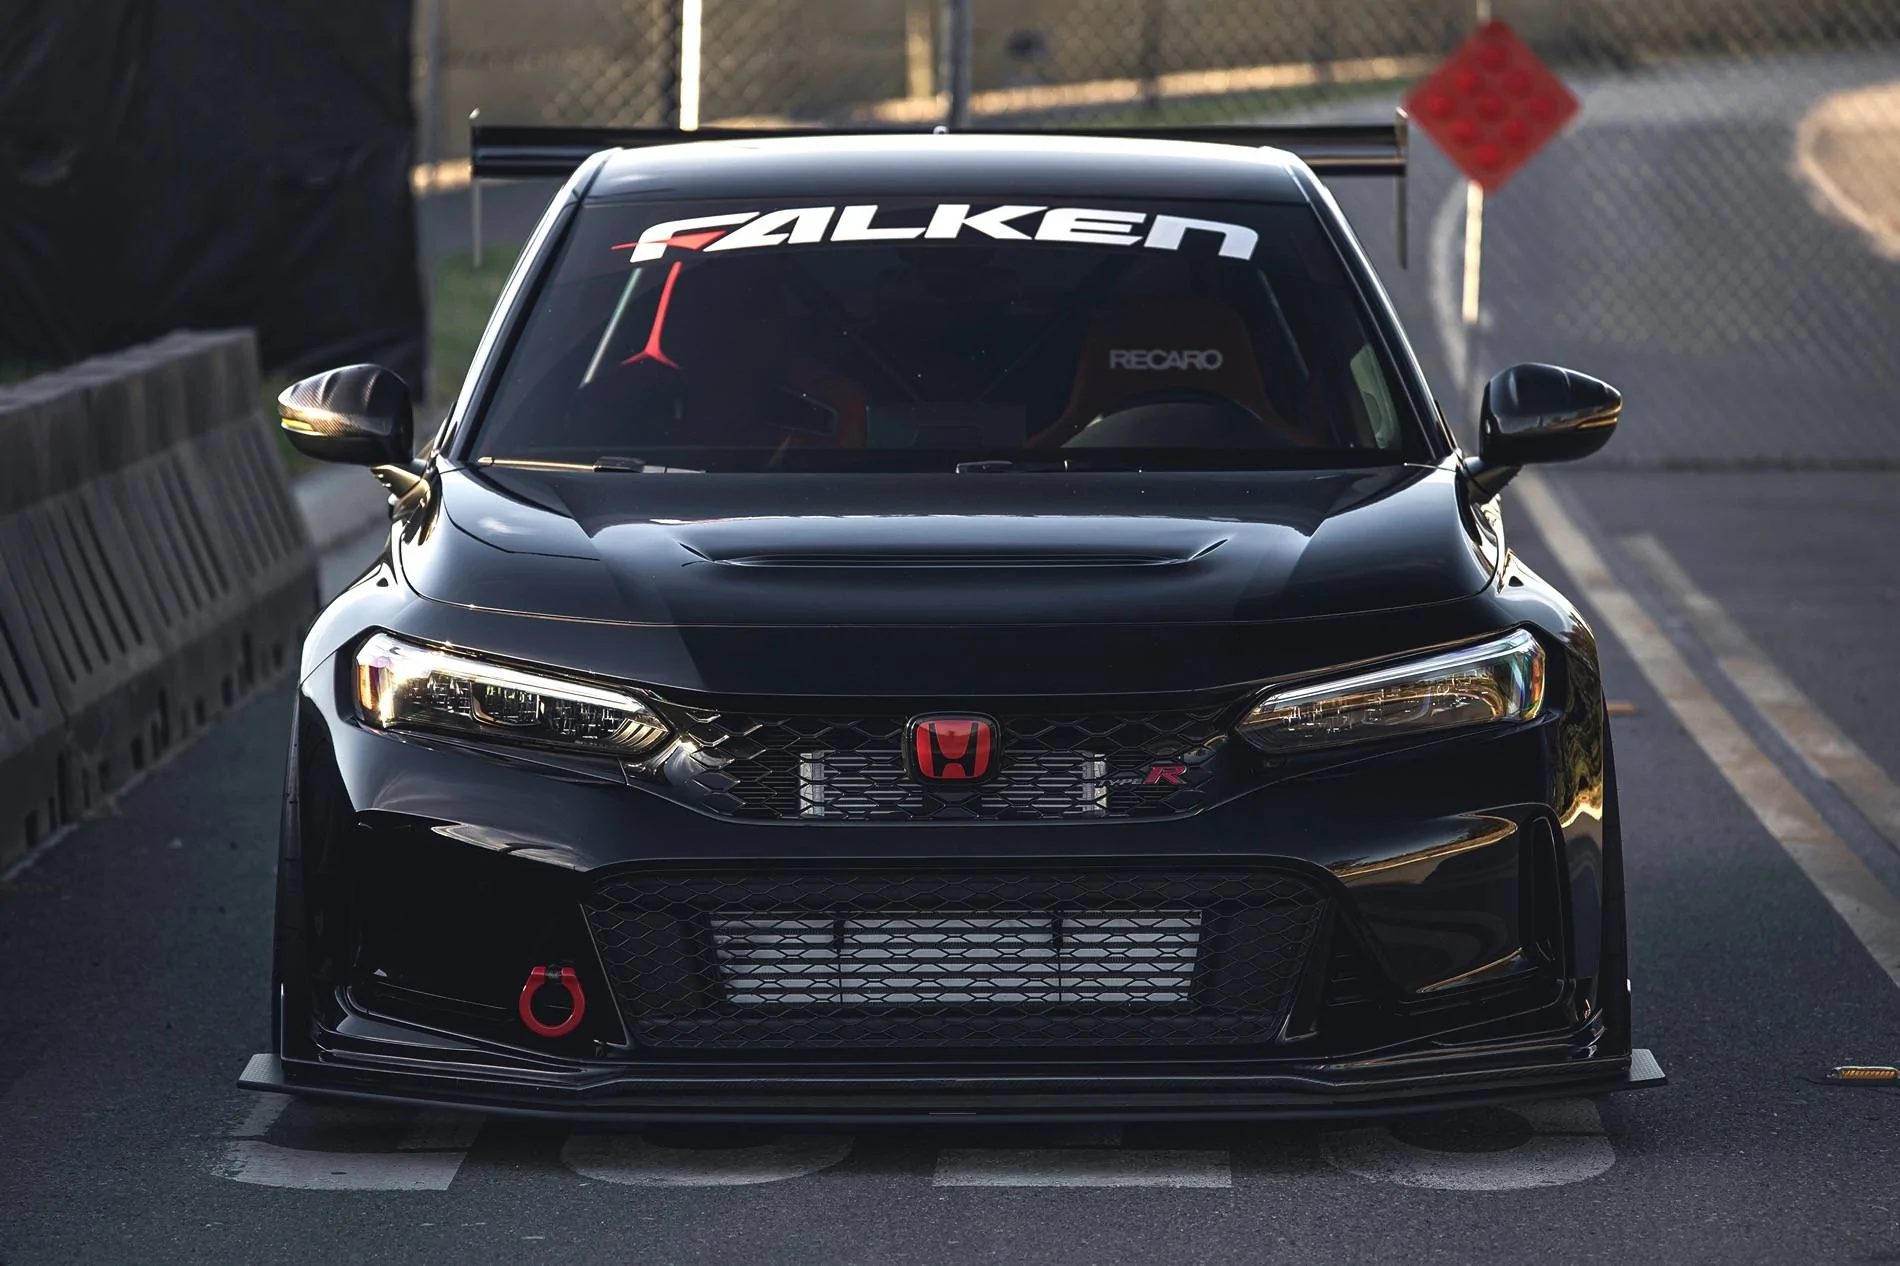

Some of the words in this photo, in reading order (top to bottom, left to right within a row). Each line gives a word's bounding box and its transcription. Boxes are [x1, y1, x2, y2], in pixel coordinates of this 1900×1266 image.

[629, 203, 1259, 262] FALKEN
[1109, 349, 1223, 370] RECARO
[1143, 764, 1187, 785] R
